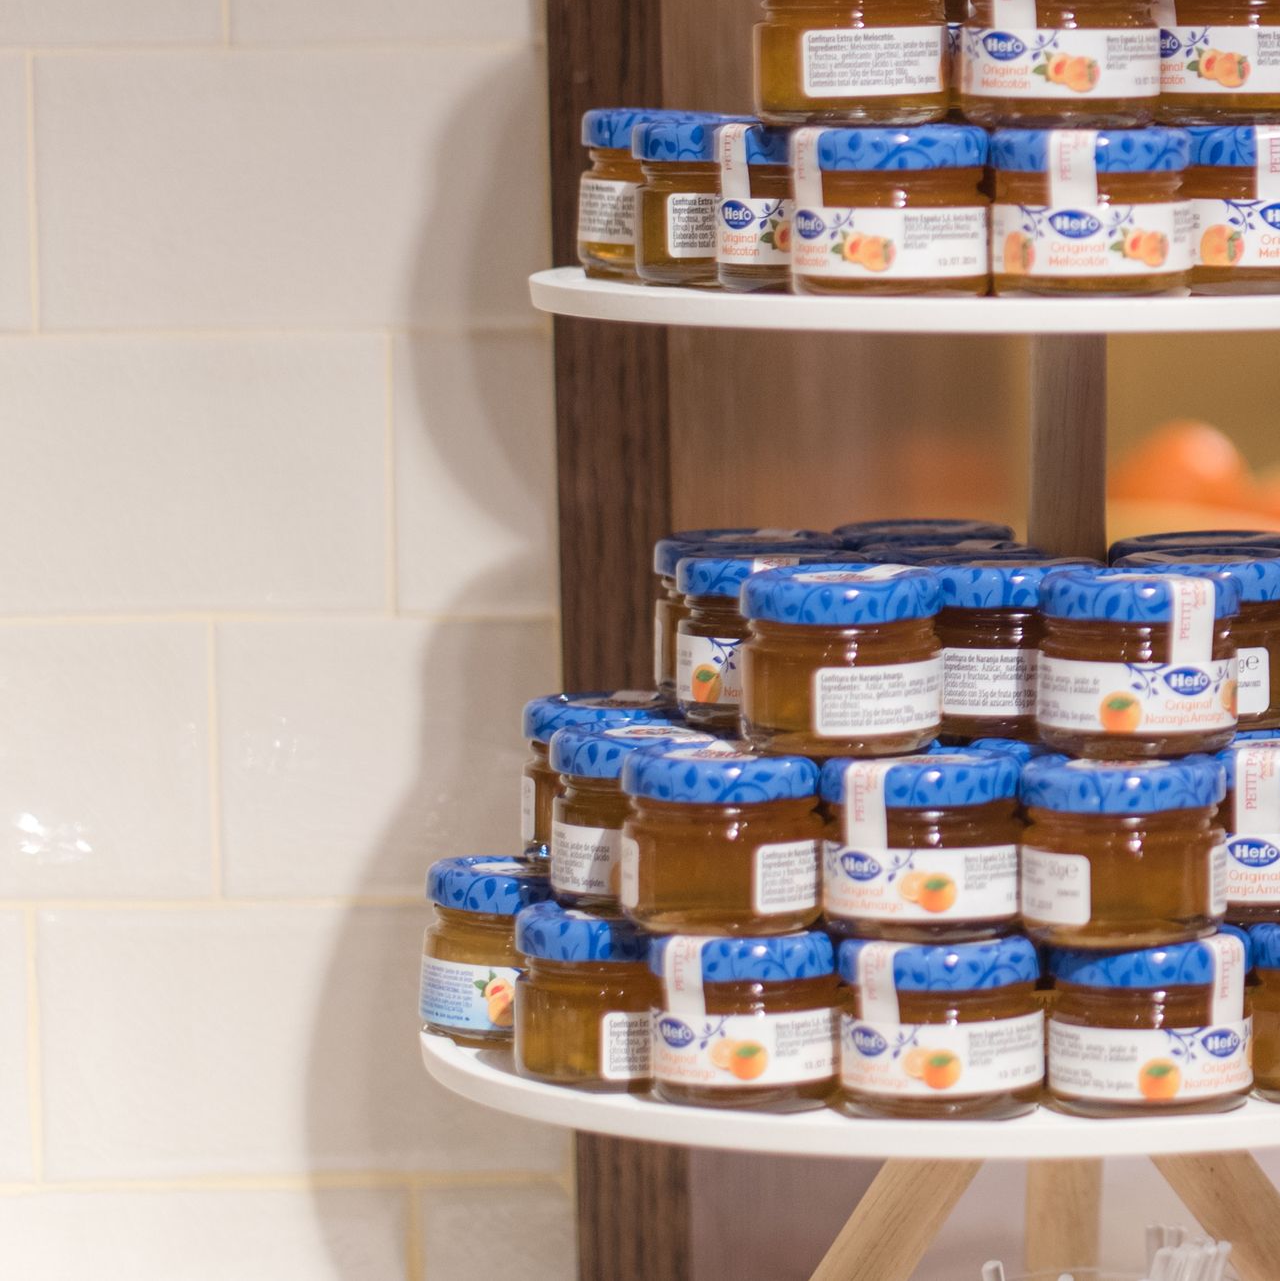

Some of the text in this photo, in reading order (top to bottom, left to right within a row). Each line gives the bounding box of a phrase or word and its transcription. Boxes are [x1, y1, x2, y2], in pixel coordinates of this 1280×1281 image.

[987, 38, 1022, 53] Hero
[983, 64, 1029, 76] Original
[981, 78, 1031, 89] Melocotón
[672, 197, 713, 206] Confitura Extra
[725, 206, 751, 220] Hero
[799, 216, 824, 231] Hero
[1055, 217, 1099, 230] Hero
[721, 232, 758, 244] Original
[721, 245, 760, 257] Melocotón
[1051, 242, 1105, 253] Original
[1049, 255, 1109, 266] Melocotón
[944, 654, 966, 662] Confitura
[976, 655, 999, 664] Naranja
[1170, 673, 1208, 687] Hero
[1165, 698, 1213, 712] Original
[1245, 773, 1257, 810] PETIT
[1235, 845, 1277, 858] Hero
[844, 857, 878, 873] Hero
[1226, 884, 1254, 896] ranja
[663, 1023, 693, 1040] Hero
[855, 1033, 885, 1049] Hero
[1208, 1034, 1239, 1048] Hero
